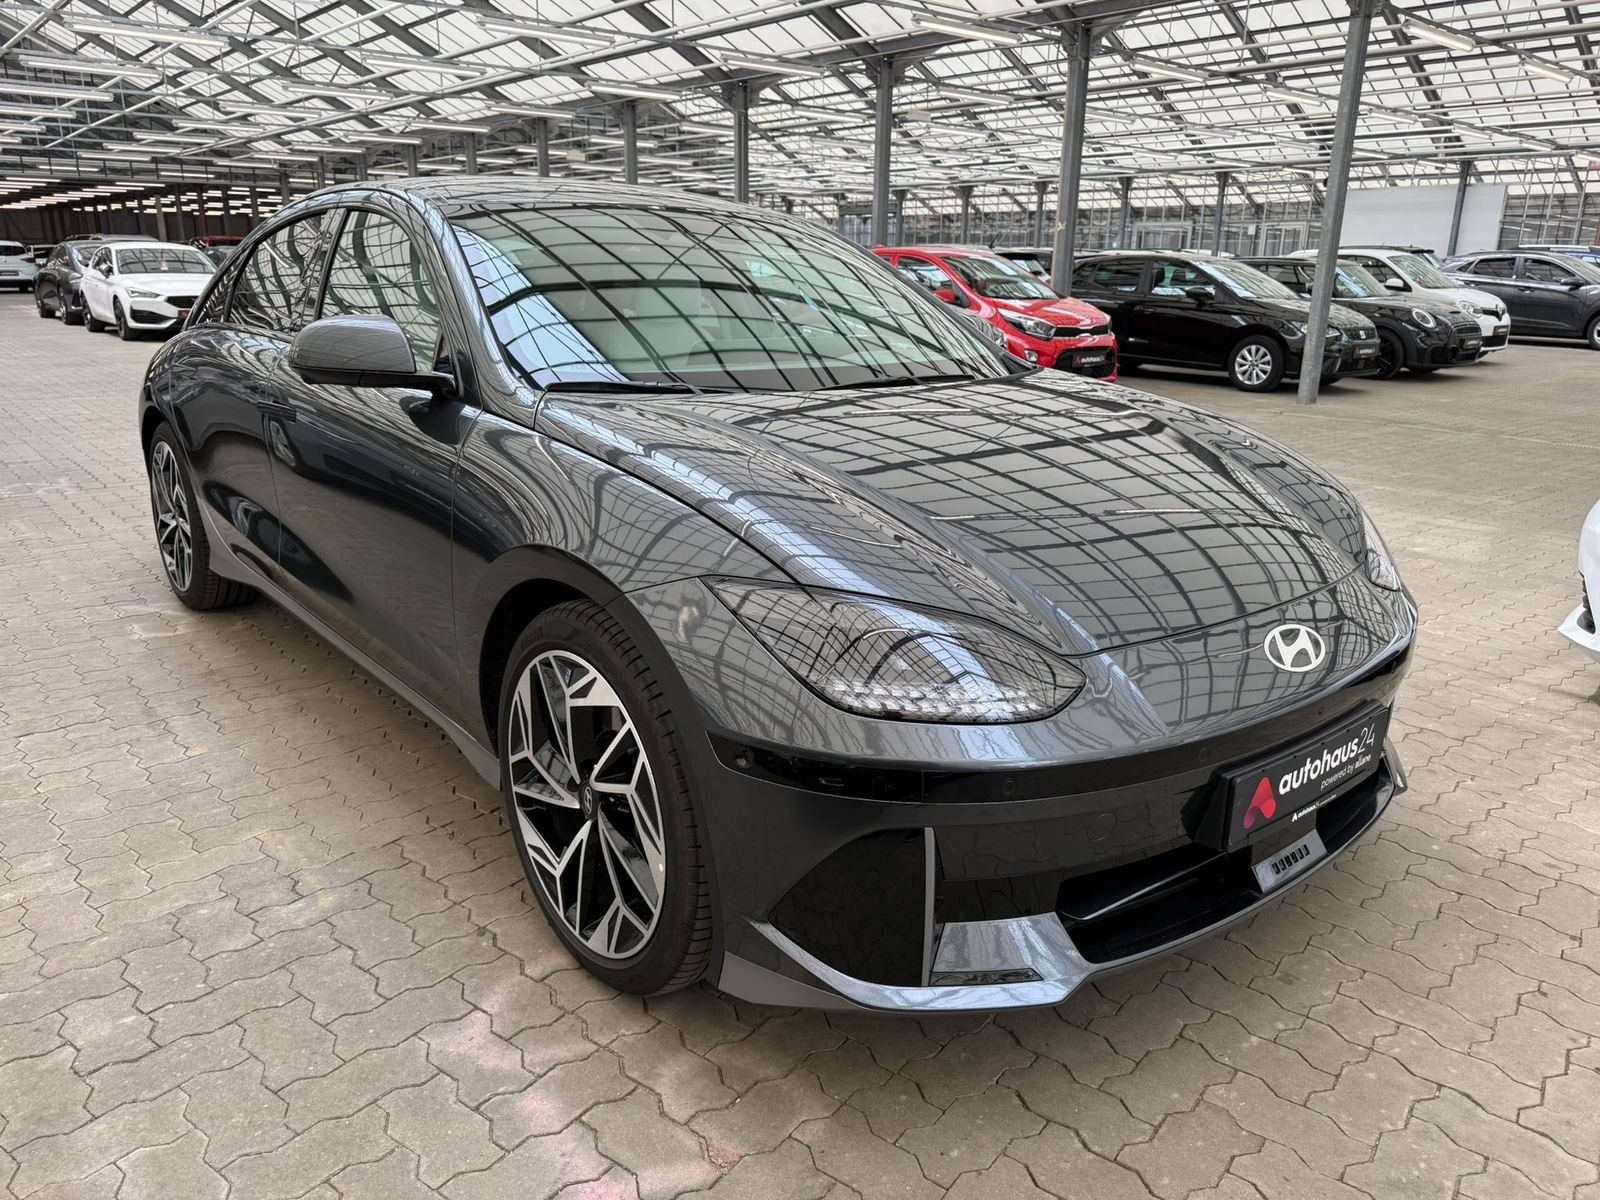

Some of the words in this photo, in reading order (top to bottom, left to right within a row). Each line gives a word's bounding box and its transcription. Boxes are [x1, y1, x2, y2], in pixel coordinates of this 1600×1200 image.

[1279, 723, 1375, 795] autohaus24
[1320, 767, 1347, 791] powered
[1347, 763, 1355, 775] by
